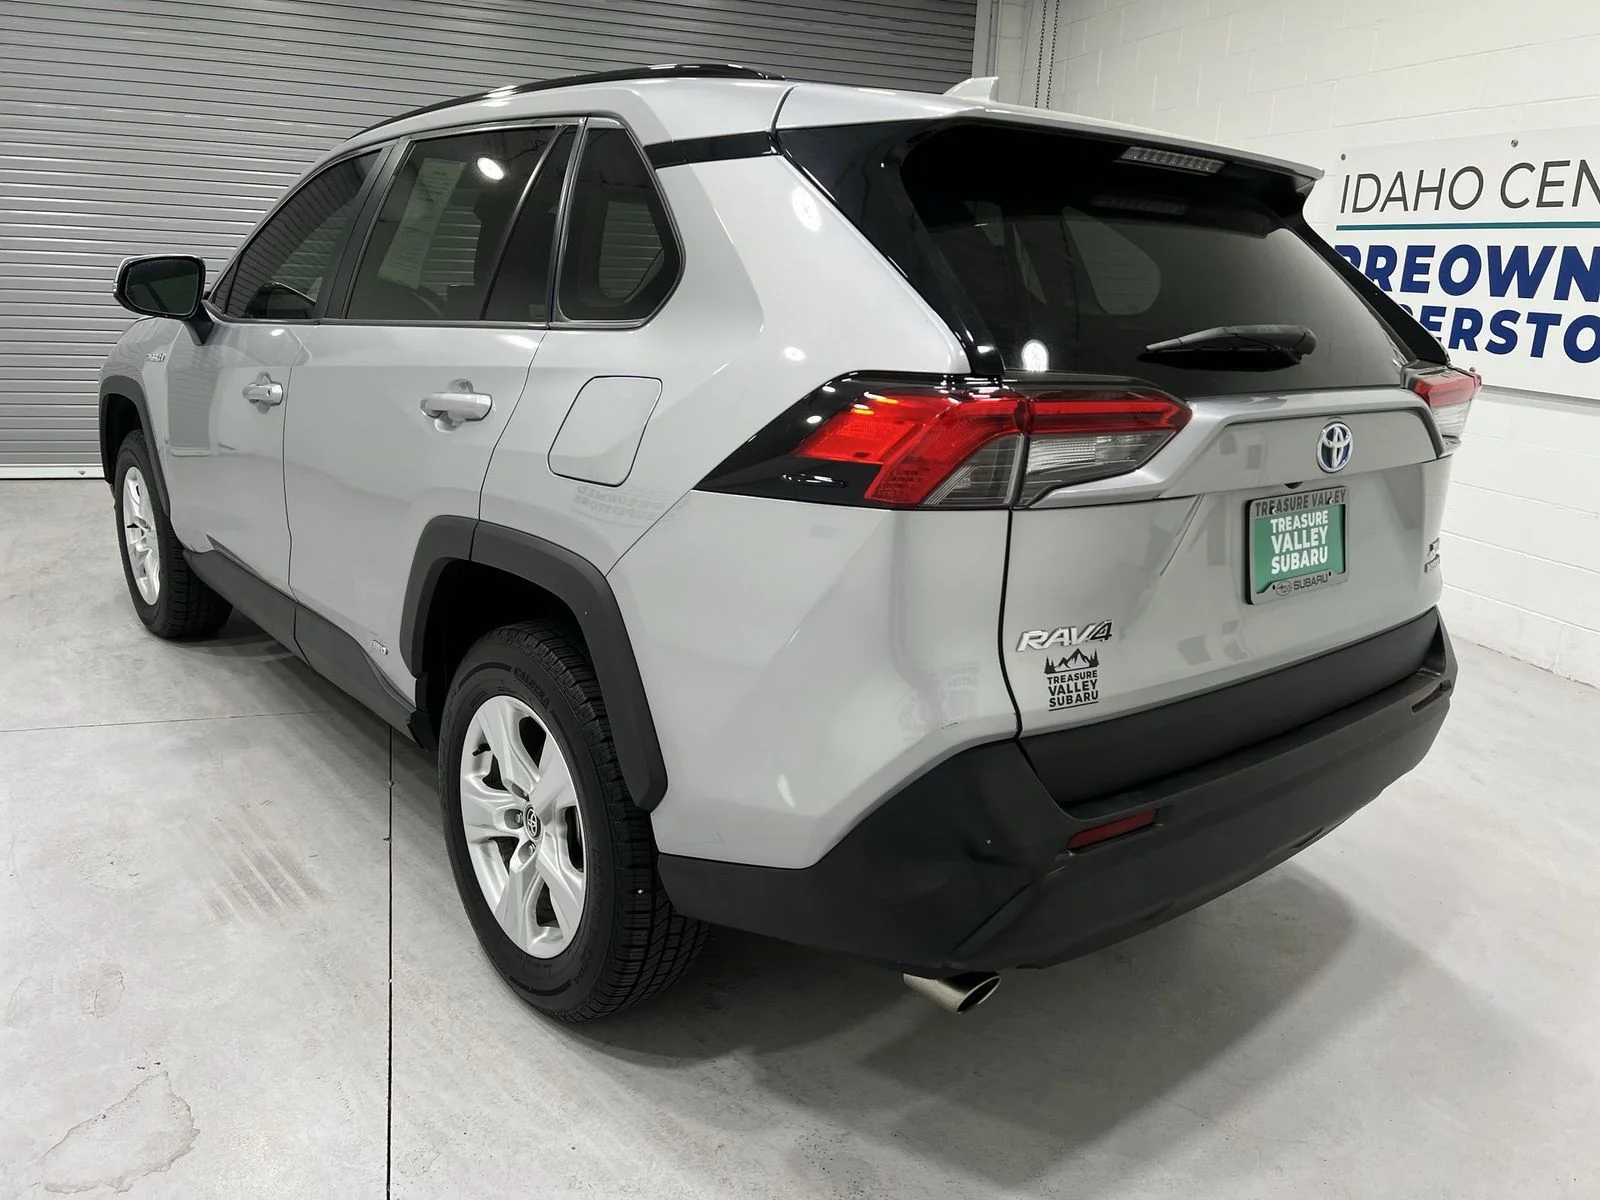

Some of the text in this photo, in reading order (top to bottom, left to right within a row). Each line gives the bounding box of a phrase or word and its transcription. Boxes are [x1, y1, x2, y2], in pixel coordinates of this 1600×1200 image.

[1340, 159, 1600, 214] IDAHO CEN
[1399, 303, 1600, 364] ERSTO
[1255, 488, 1346, 517] TREASURE VALLEY
[1270, 510, 1328, 533] TREASURE
[1271, 525, 1328, 554] VALLEY
[1271, 546, 1328, 575] SUBARU
[1293, 573, 1328, 590] SUBARU
[1016, 619, 1112, 652] RAV4
[1047, 669, 1098, 685] TREASURE
[1048, 679, 1098, 697] VALLEY
[1049, 690, 1099, 708] SUBARU
